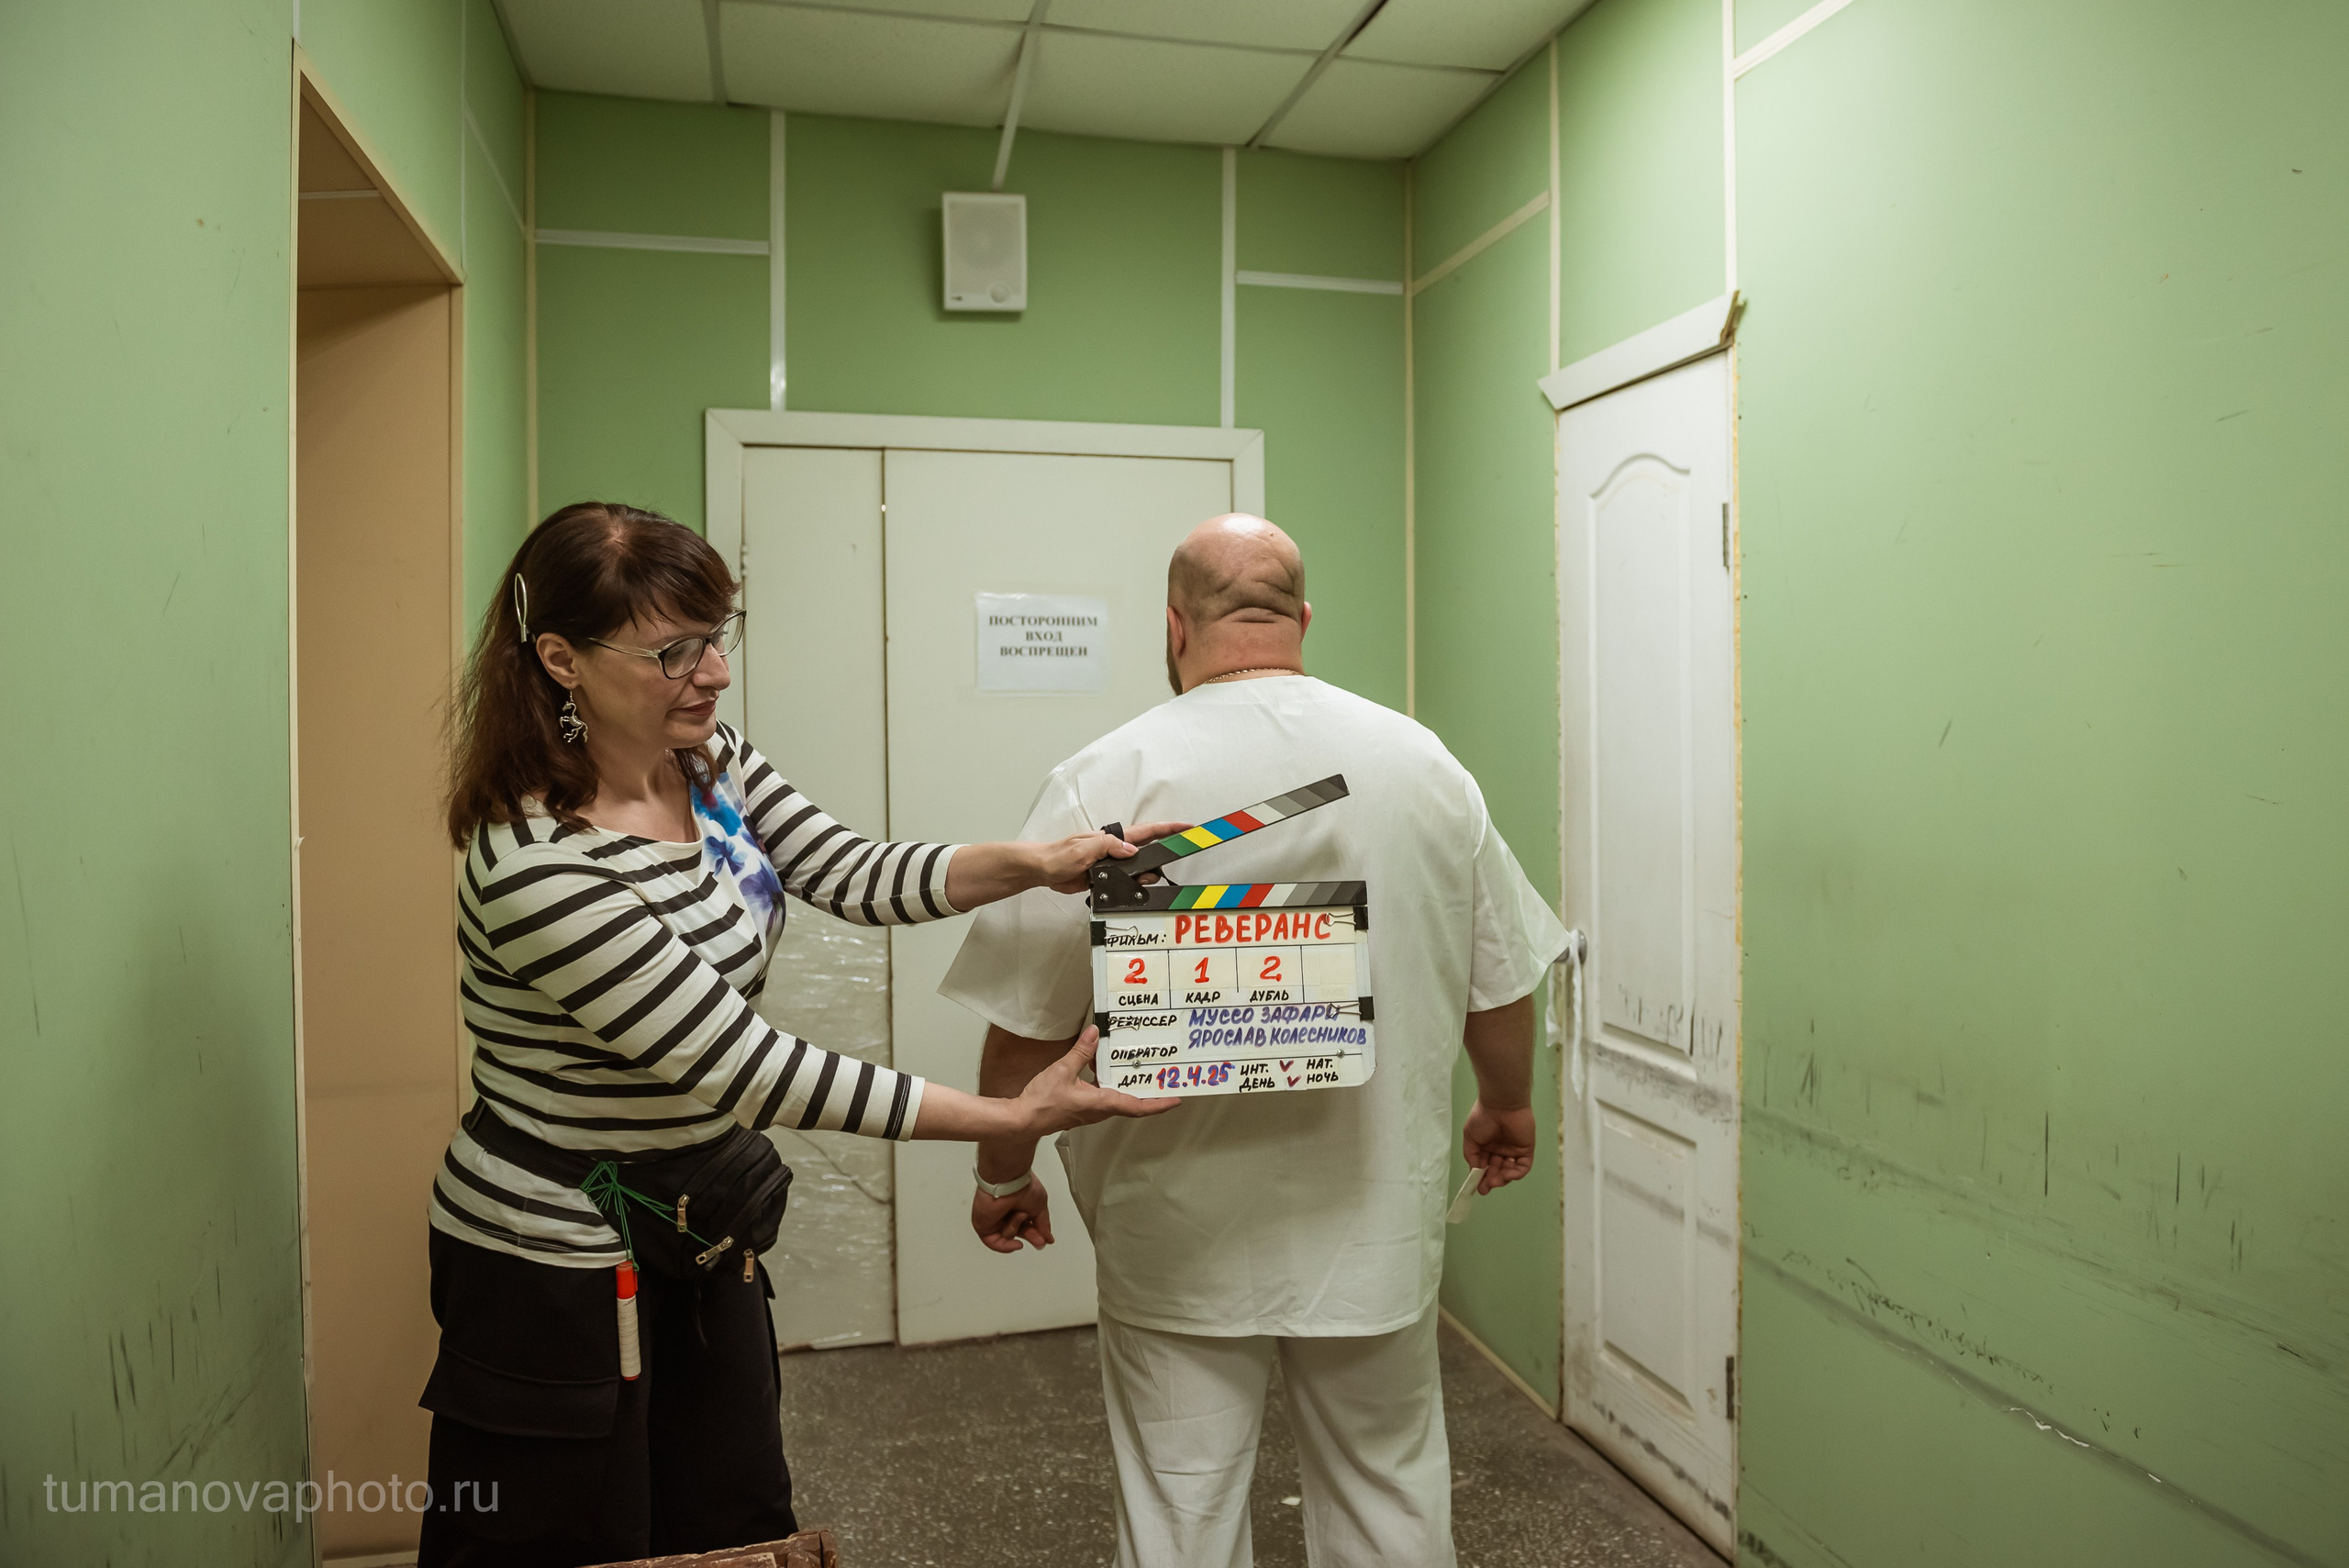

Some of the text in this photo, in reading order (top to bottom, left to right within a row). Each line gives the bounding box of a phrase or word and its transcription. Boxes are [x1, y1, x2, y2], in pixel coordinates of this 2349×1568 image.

[988, 615, 1098, 627] ПОСТОРОННИМ
[1025, 630, 1063, 642] ВХОД
[999, 646, 1088, 658] ВОСПРЕЩЕН
[1174, 913, 1331, 944] РЕВЕРАНС
[1123, 957, 1148, 984] 2
[1194, 957, 1210, 984] 1
[1259, 955, 1282, 982] 2
[1119, 993, 1159, 1006] СЦЕНА
[1185, 991, 1221, 1004] КАДР
[1249, 990, 1289, 1003] ДУБЛЬ
[1187, 1026, 1267, 1050] ЯРОСЛАВ
[1110, 1046, 1178, 1060] ОПЕРАТОР
[1240, 1063, 1269, 1075] ИНТ.
[1306, 1058, 1333, 1070] НАТ.
[1118, 1062, 1235, 1090] ДАТА 12.4.25
[1307, 1072, 1339, 1084] НОЧЬ
[1239, 1077, 1275, 1093] ДЕНЬ
